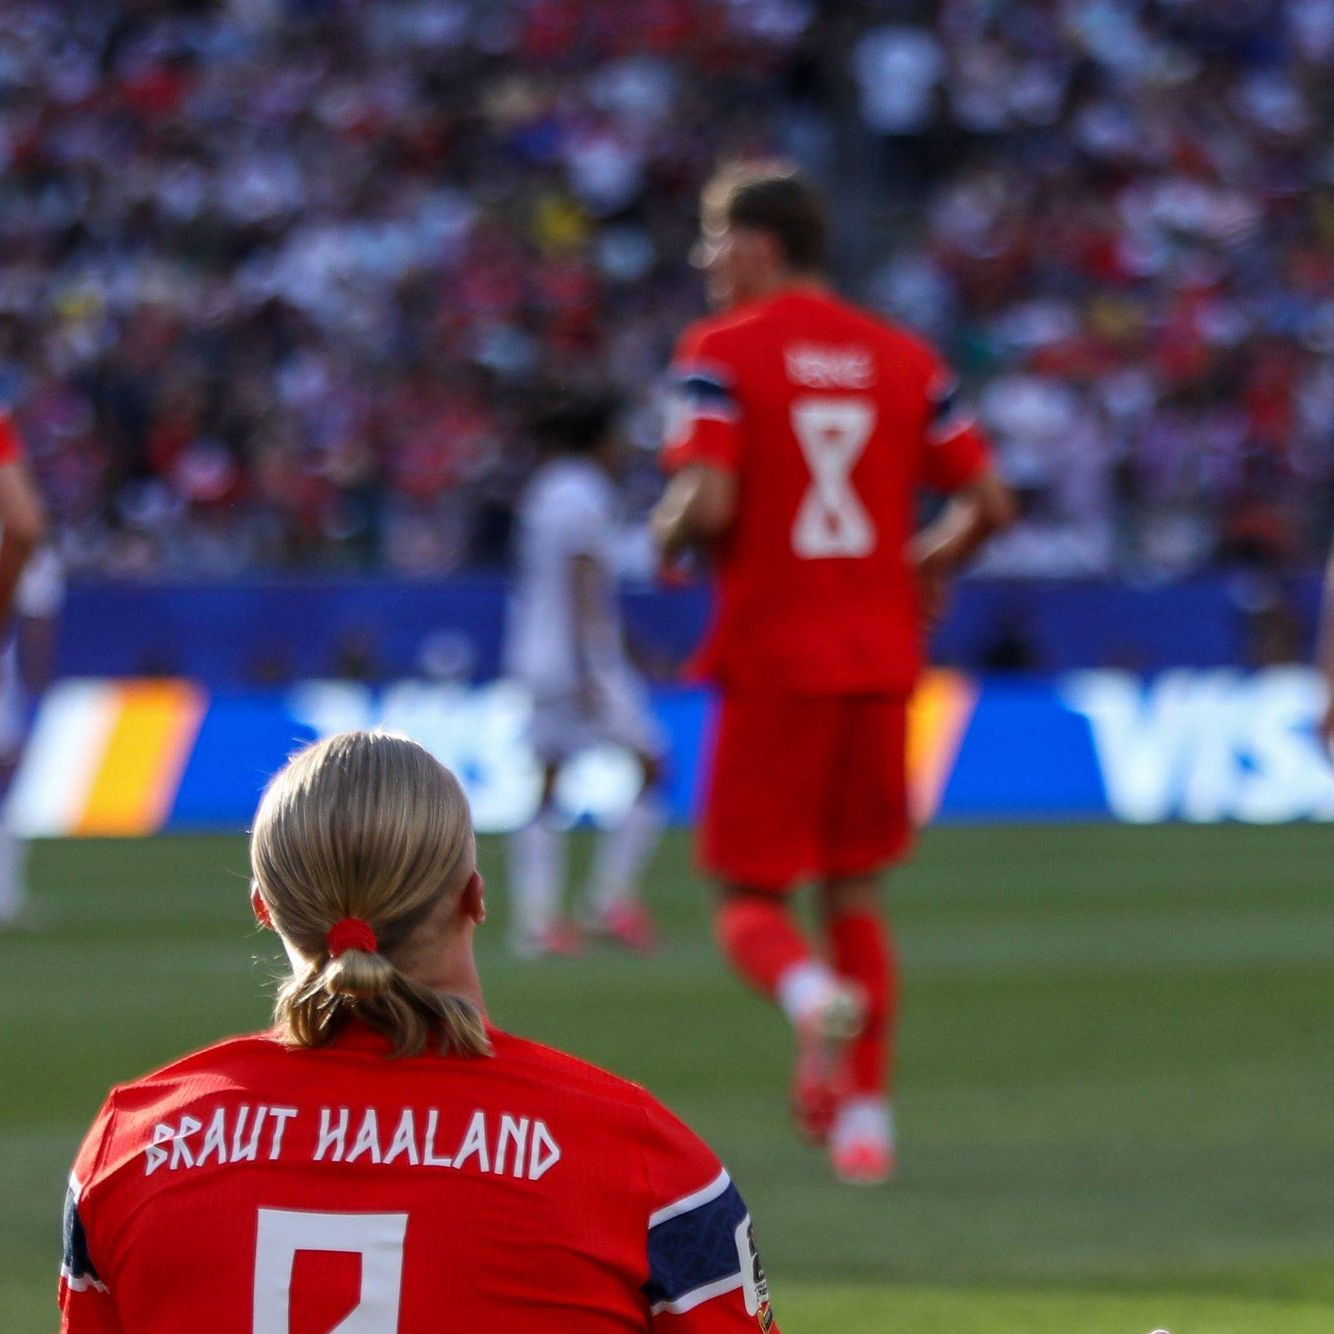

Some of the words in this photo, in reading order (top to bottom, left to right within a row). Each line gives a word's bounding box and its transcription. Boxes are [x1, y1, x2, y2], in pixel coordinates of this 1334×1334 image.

[788, 397, 879, 560] 8
[144, 1105, 297, 1177] BRAUT
[312, 1107, 562, 1182] HAALAND
